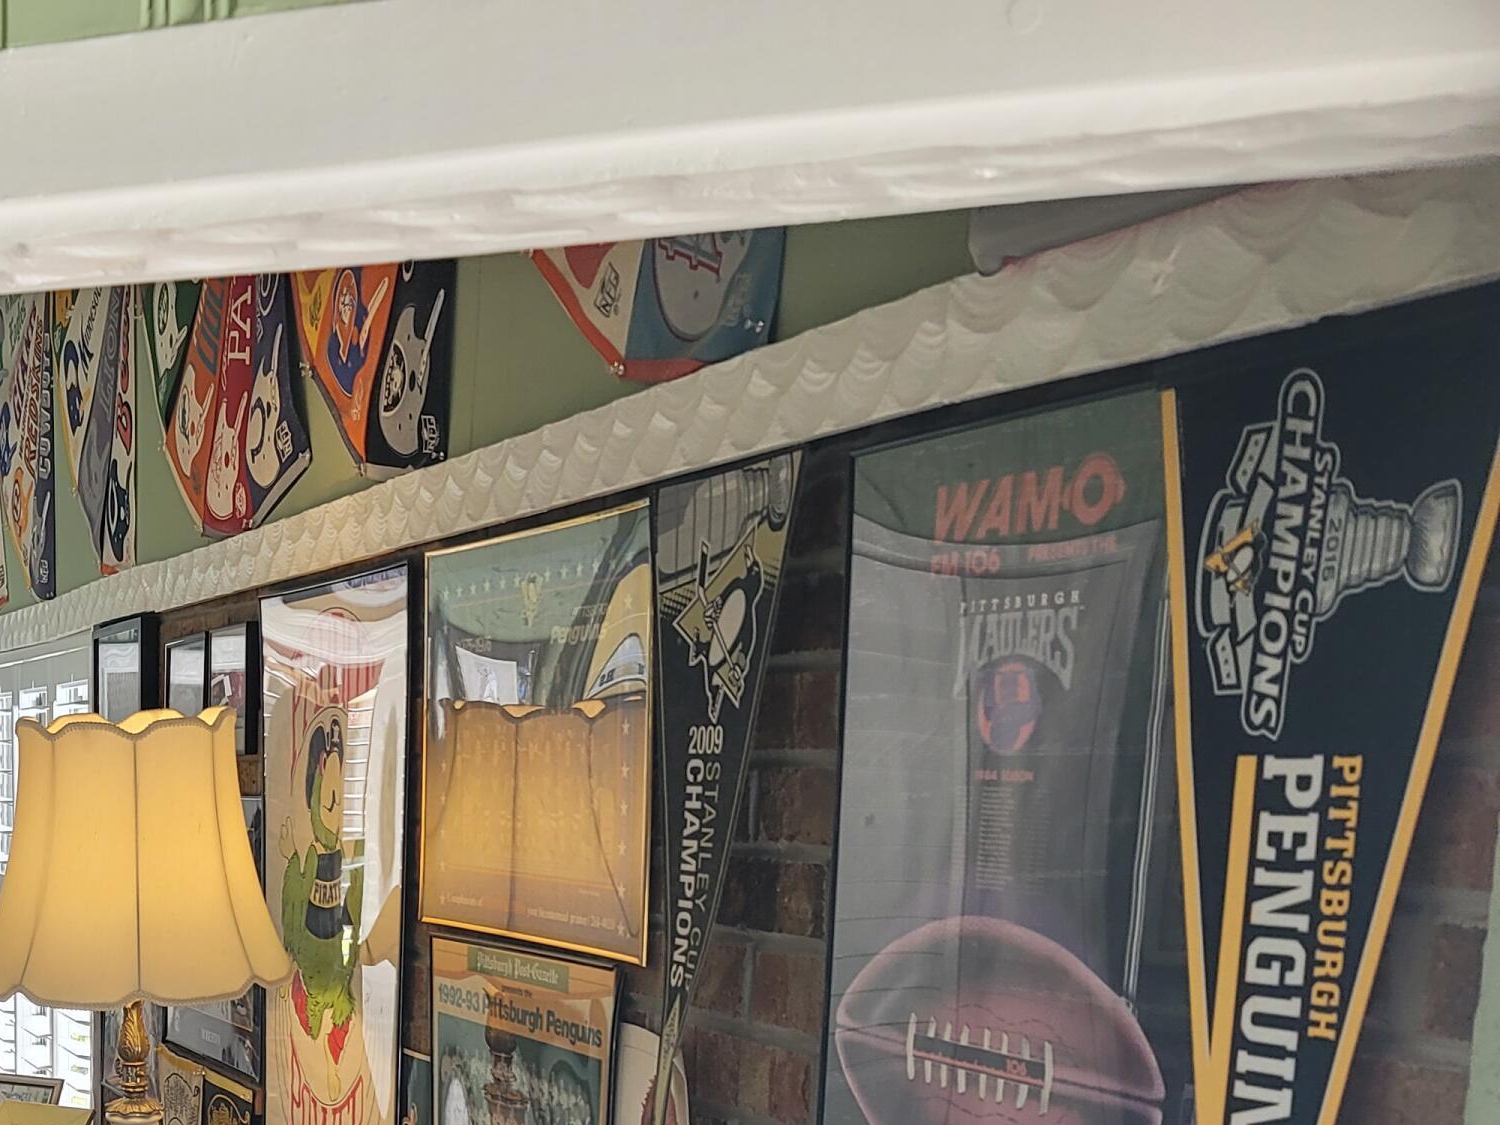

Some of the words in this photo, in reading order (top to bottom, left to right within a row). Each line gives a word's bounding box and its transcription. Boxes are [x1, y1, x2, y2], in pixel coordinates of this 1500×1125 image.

[101, 284, 125, 422] LION
[934, 452, 1125, 545] WAMO
[1301, 450, 1332, 584] STANLEY
[1250, 379, 1317, 730] CHAMPIONS
[1322, 517, 1343, 583] 2016
[959, 590, 1081, 615] PITTSBURGH
[1292, 589, 1315, 653] CUP
[953, 605, 1079, 700] MAULERS
[688, 726, 723, 754] 2009
[670, 758, 705, 989] CHAMPIONS
[695, 761, 721, 912] STANLEY
[1307, 754, 1363, 1043] PITTSBURGH
[438, 982, 479, 1013] 1992-93
[481, 992, 543, 1034] Pittsburgh
[546, 1009, 603, 1048] Penguins
